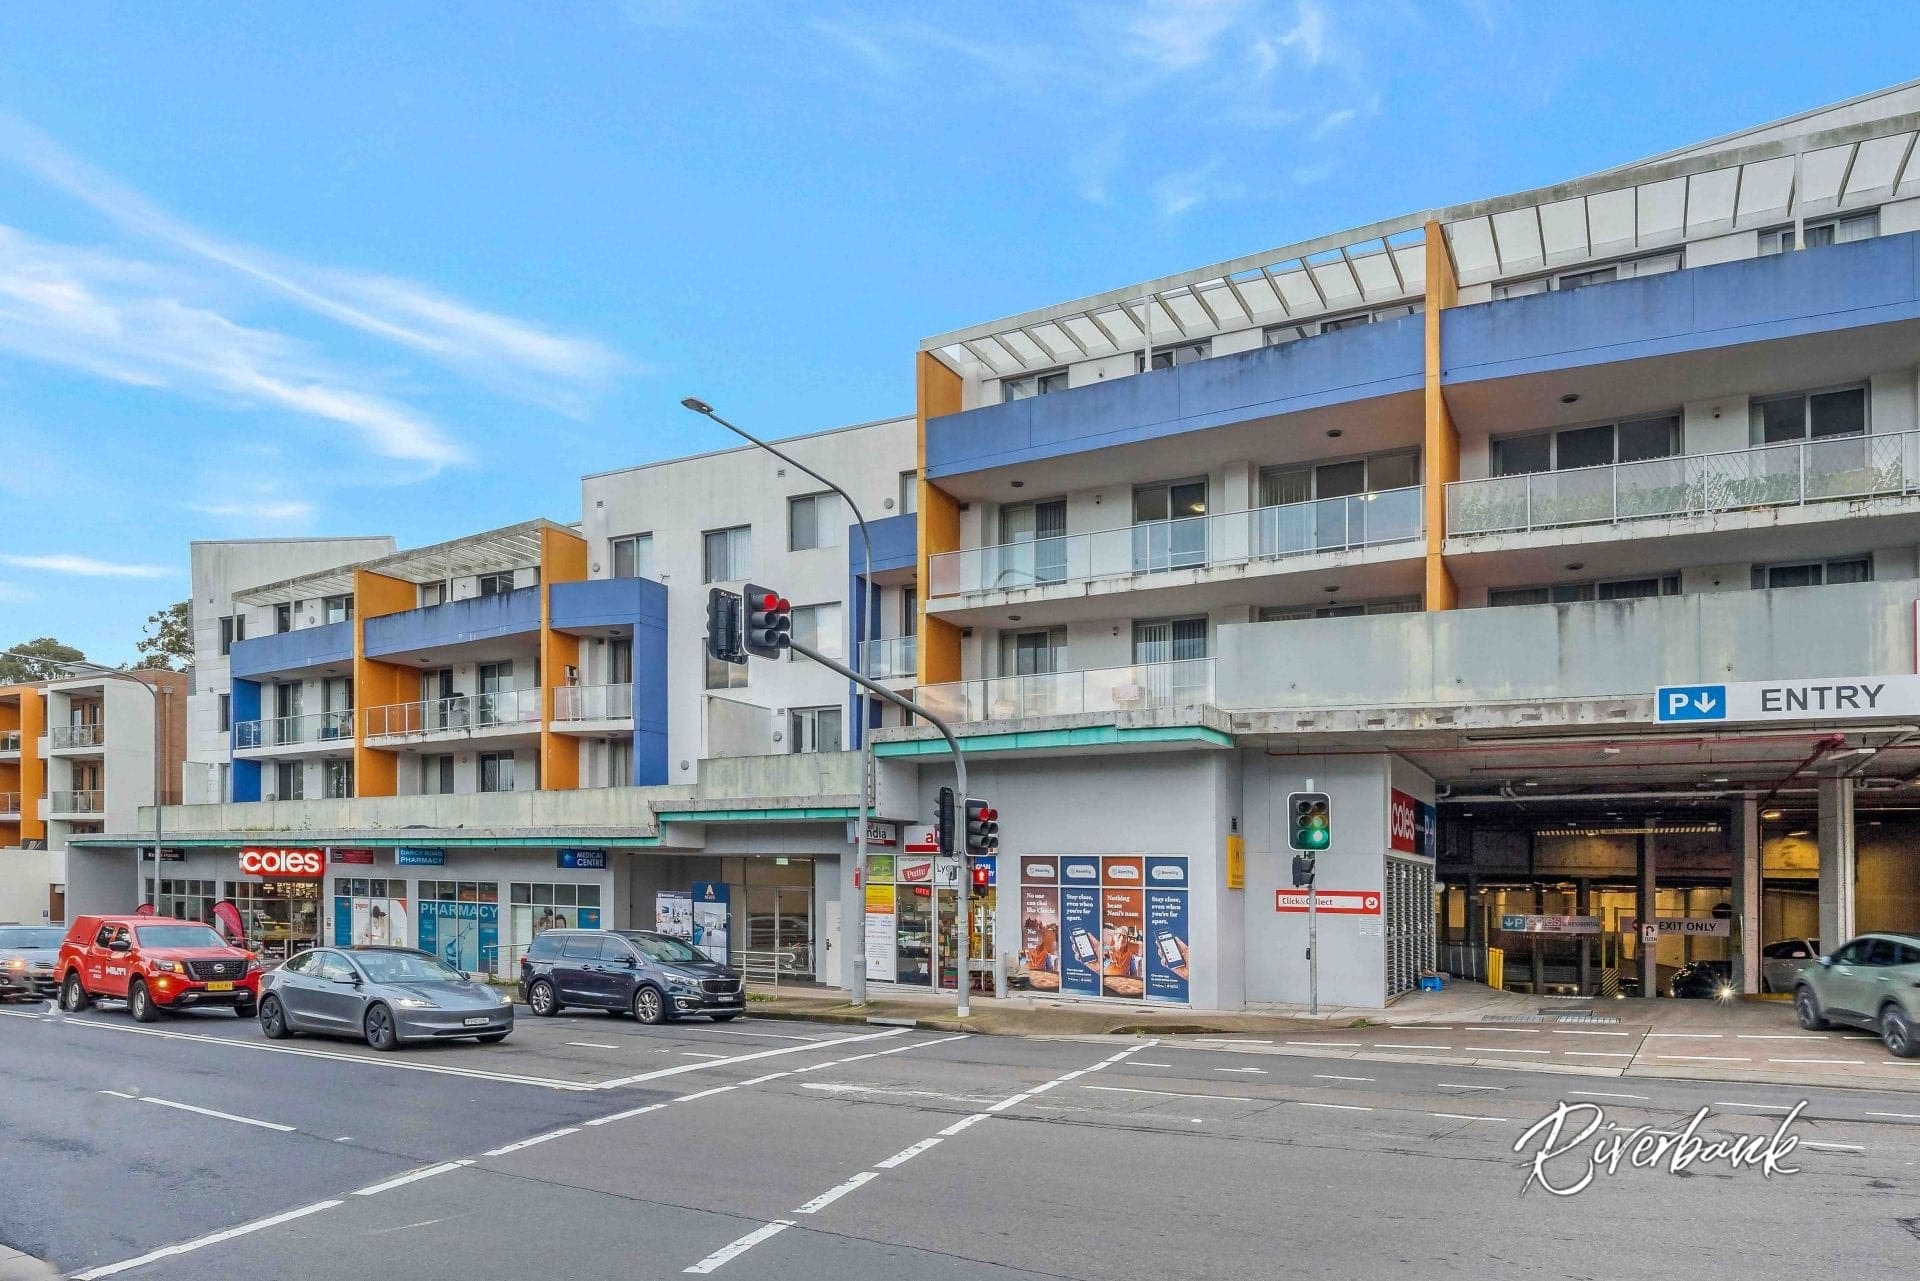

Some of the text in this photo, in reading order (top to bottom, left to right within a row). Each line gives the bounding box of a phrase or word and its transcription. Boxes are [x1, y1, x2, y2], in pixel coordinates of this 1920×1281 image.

[1669, 684, 1885, 715] P ENTRY
[1392, 800, 1415, 841] coles
[866, 825, 887, 839] ndia
[400, 856, 444, 864] PHARMACY
[576, 851, 604, 859] MEDICAL
[243, 851, 320, 873] coles
[576, 859, 604, 867] CENTRE
[1107, 894, 1130, 903] Nothing
[420, 903, 498, 918] PHARMACY
[1526, 917, 1561, 926] coles
[1658, 921, 1717, 932] EXIT ONLY
